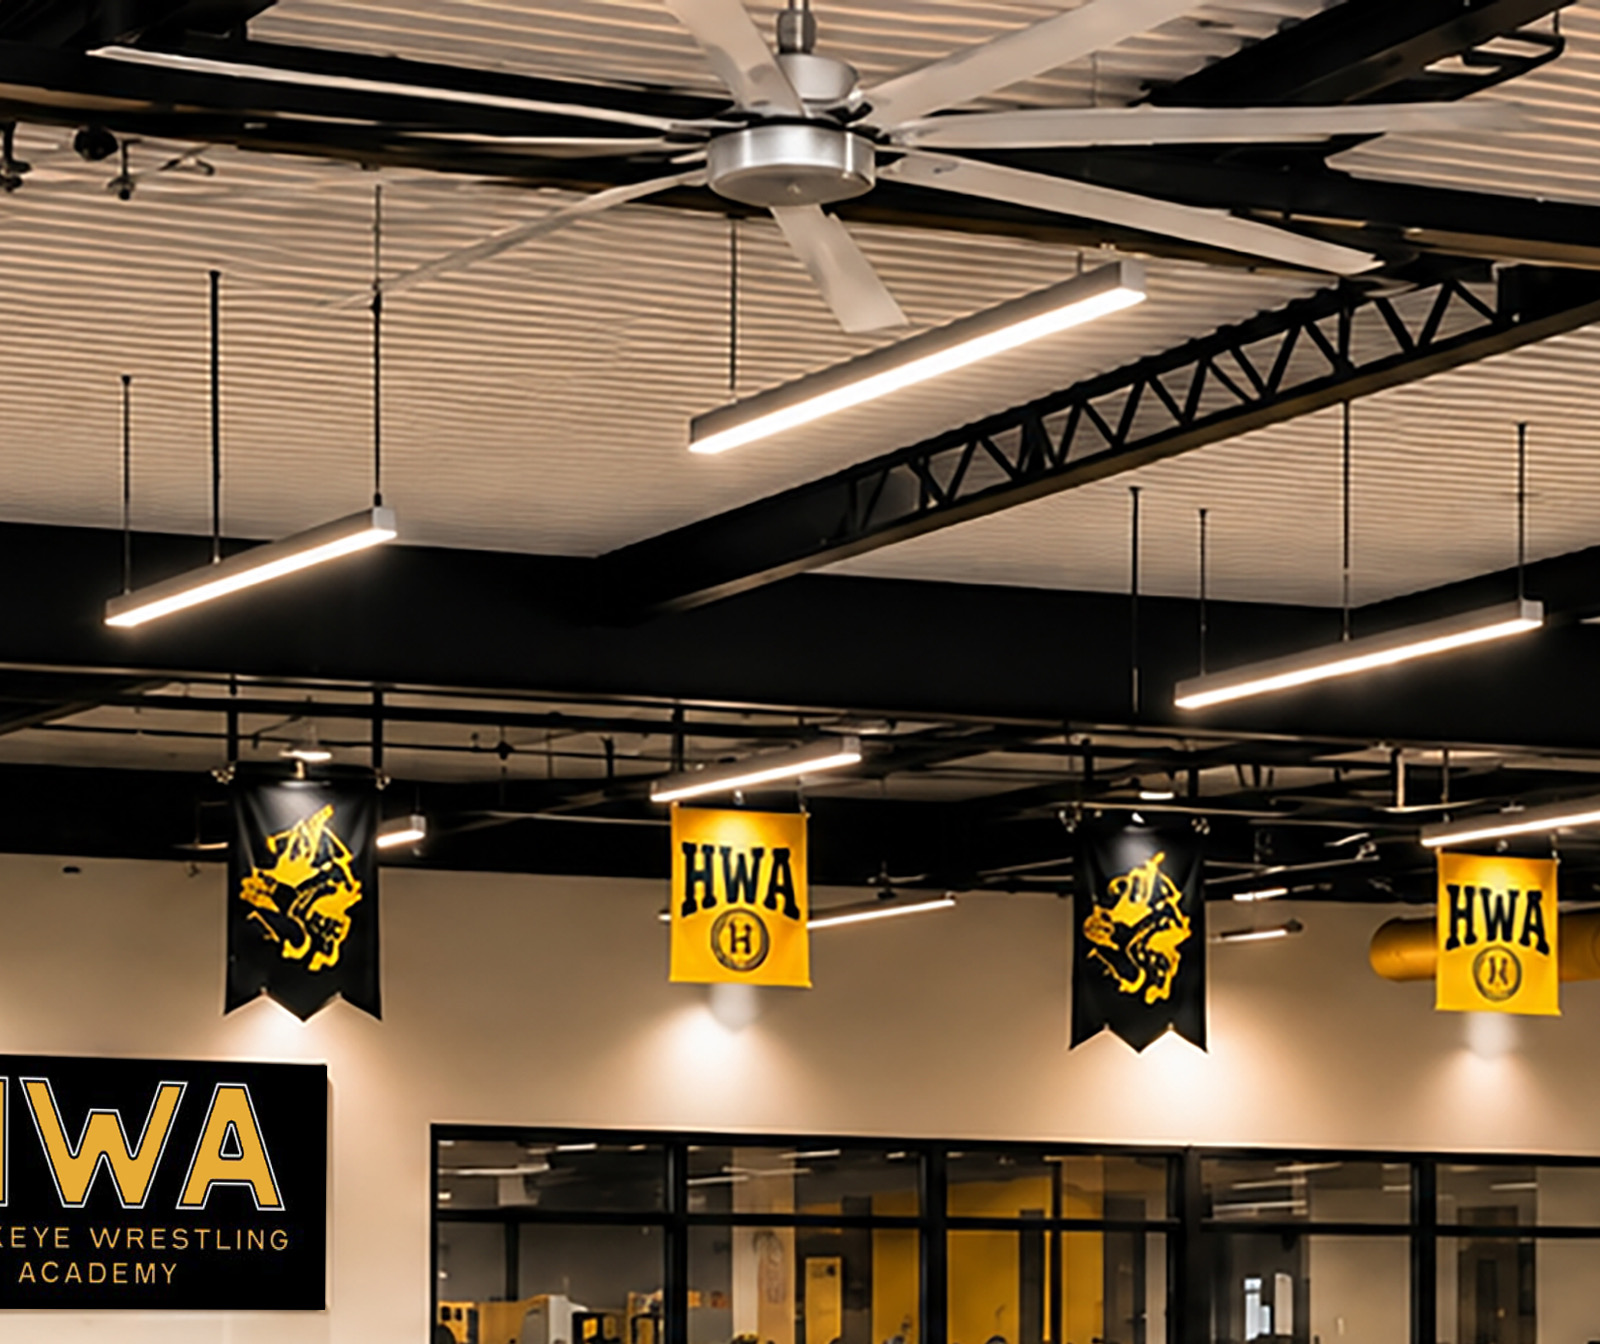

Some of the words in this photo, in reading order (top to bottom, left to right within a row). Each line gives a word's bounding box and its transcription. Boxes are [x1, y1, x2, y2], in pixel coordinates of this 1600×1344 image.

[681, 841, 801, 921] HWA
[1445, 883, 1550, 956] HWA
[89, 1226, 290, 1251] WRESTLING
[17, 1261, 178, 1285] ACADEMY
